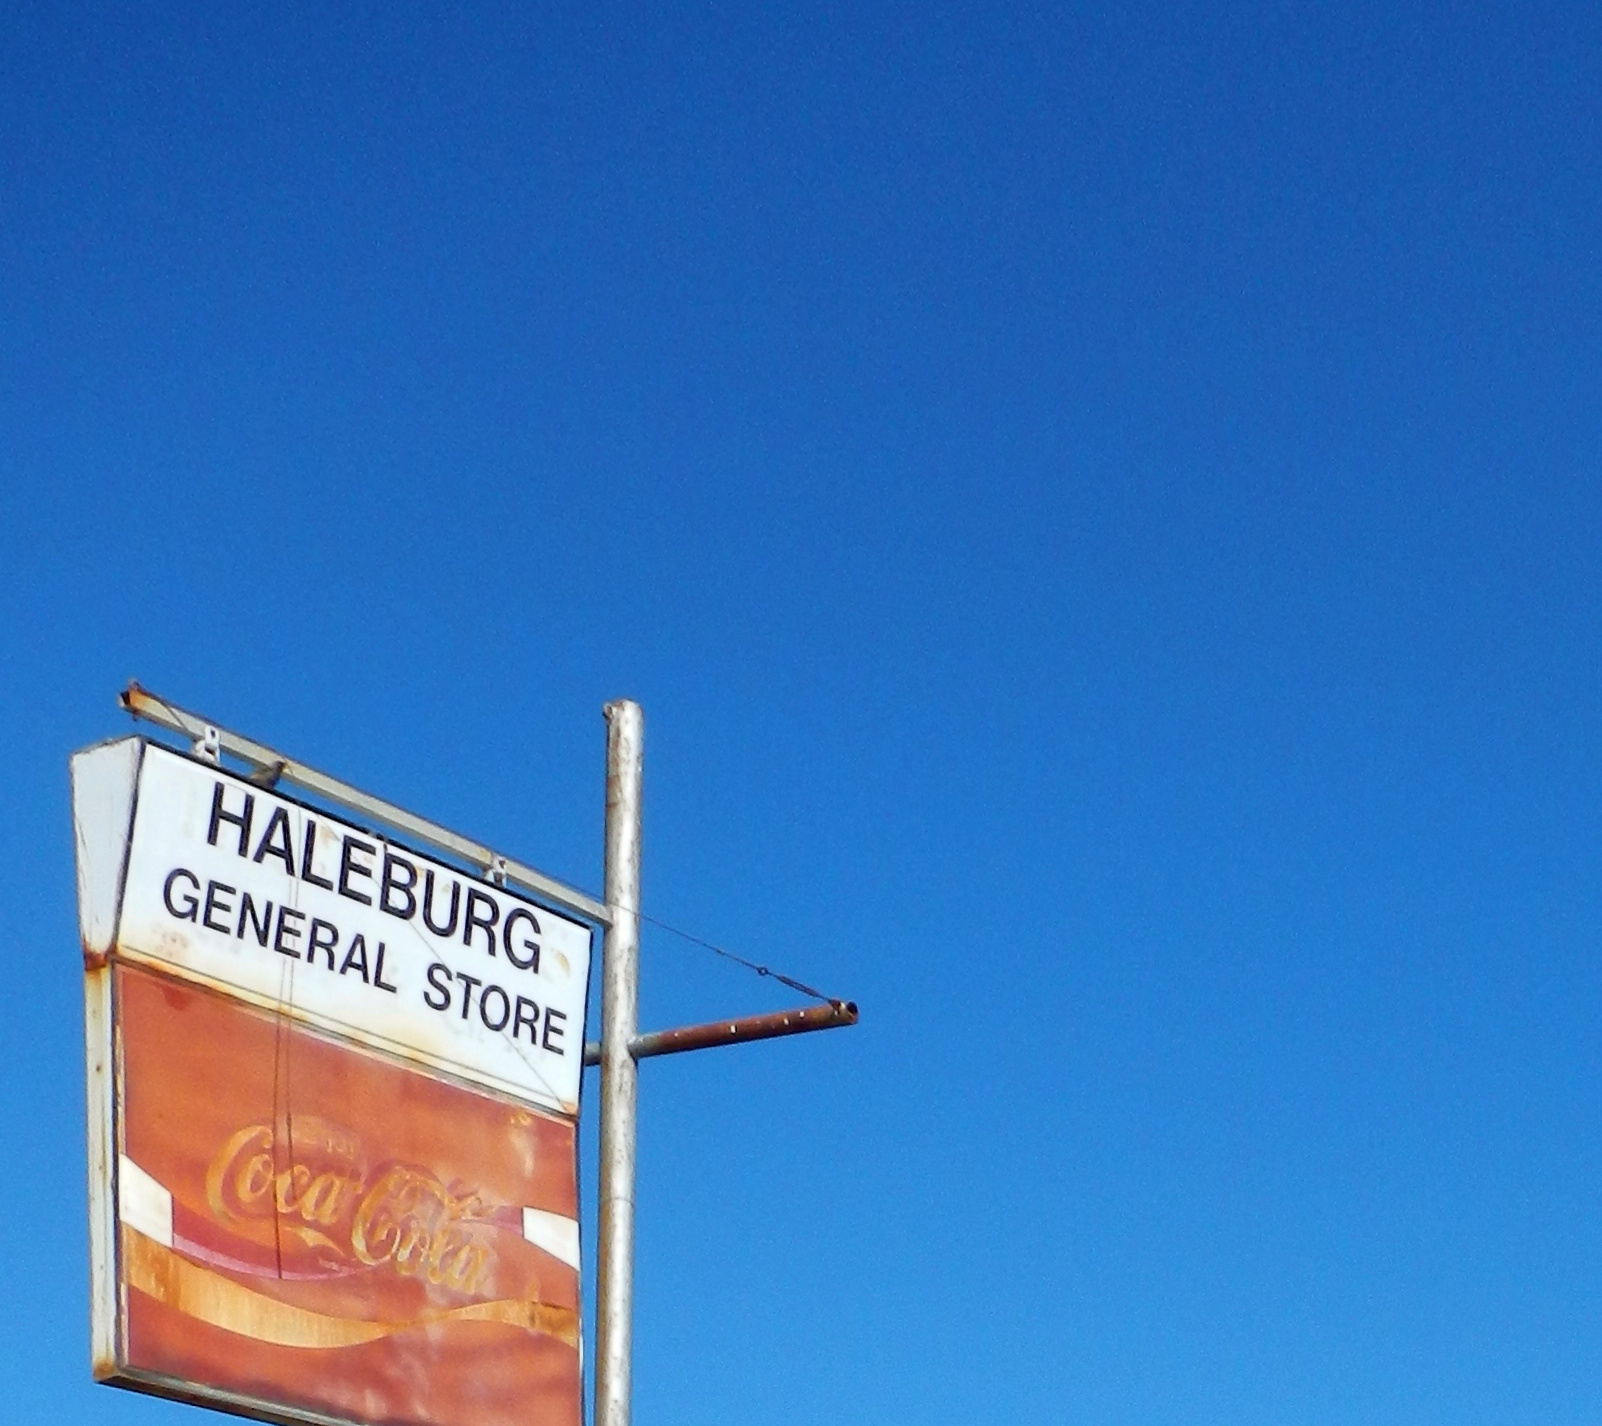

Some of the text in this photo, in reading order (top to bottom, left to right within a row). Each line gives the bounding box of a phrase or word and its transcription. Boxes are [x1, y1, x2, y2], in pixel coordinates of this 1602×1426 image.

[163, 867, 568, 1056] GENERAL STORE
[206, 781, 542, 974] HALEBURG
